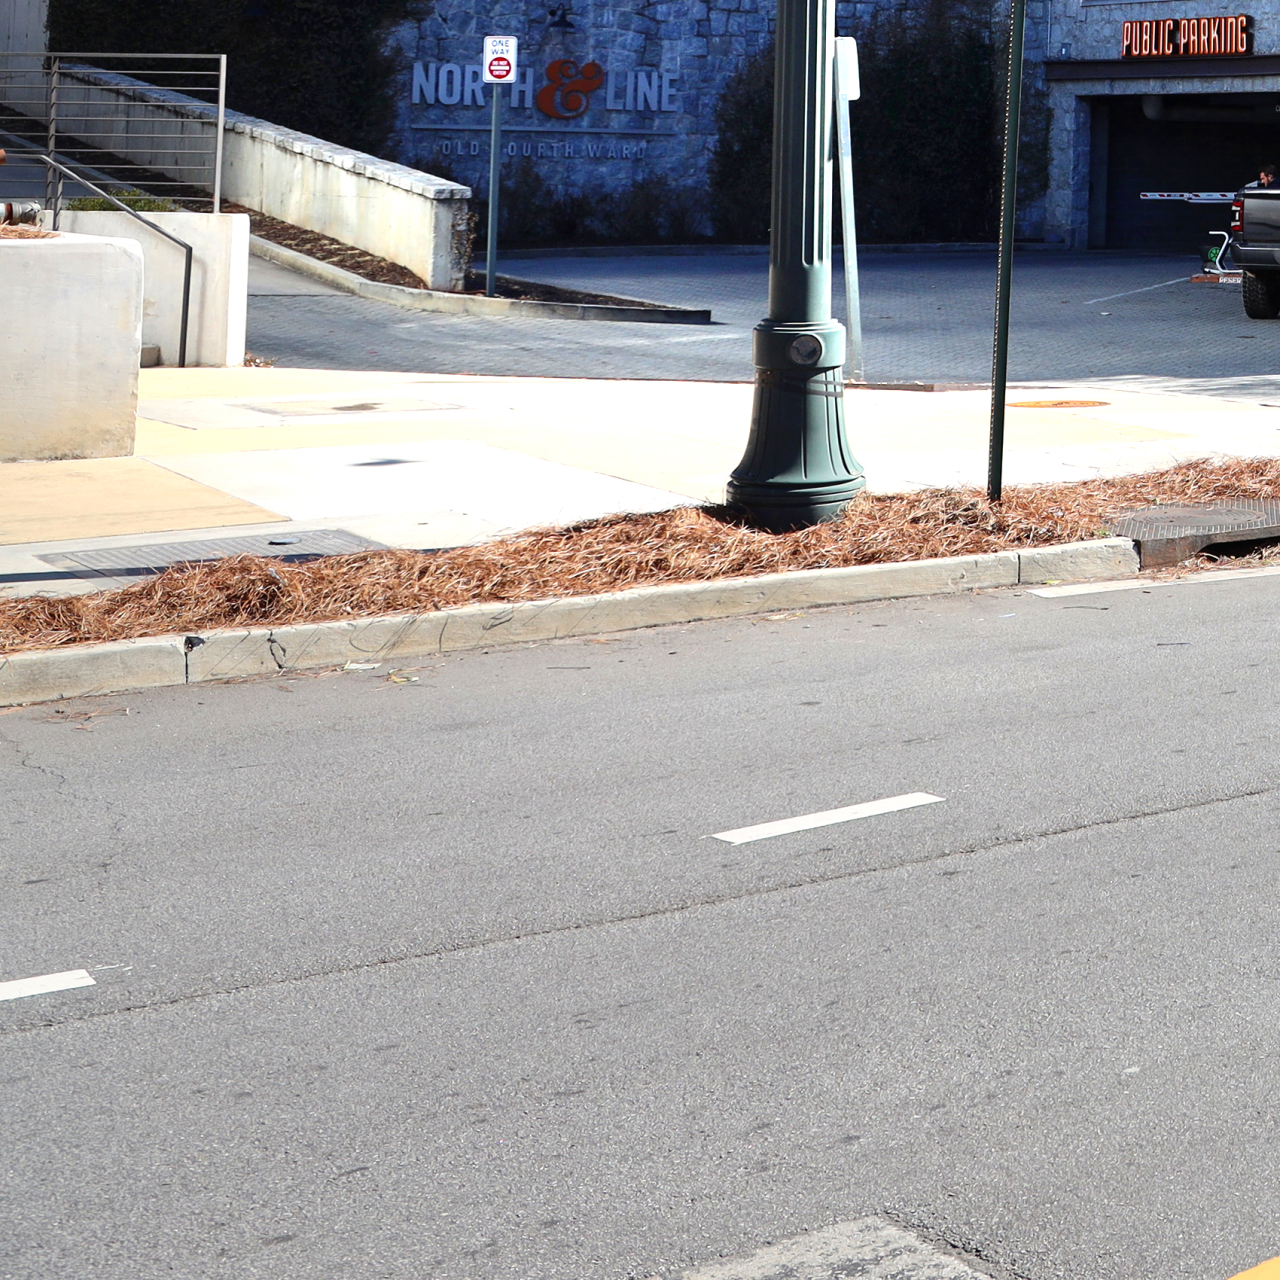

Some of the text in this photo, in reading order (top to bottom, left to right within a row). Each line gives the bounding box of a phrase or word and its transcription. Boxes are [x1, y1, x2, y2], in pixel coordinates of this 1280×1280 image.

[1122, 15, 1247, 56] PUBLIC PARKING
[411, 62, 534, 109] NORH
[605, 70, 679, 112] LINE
[442, 142, 646, 159] OLD OURTH WARD
[1219, 276, 1242, 284] RESER
